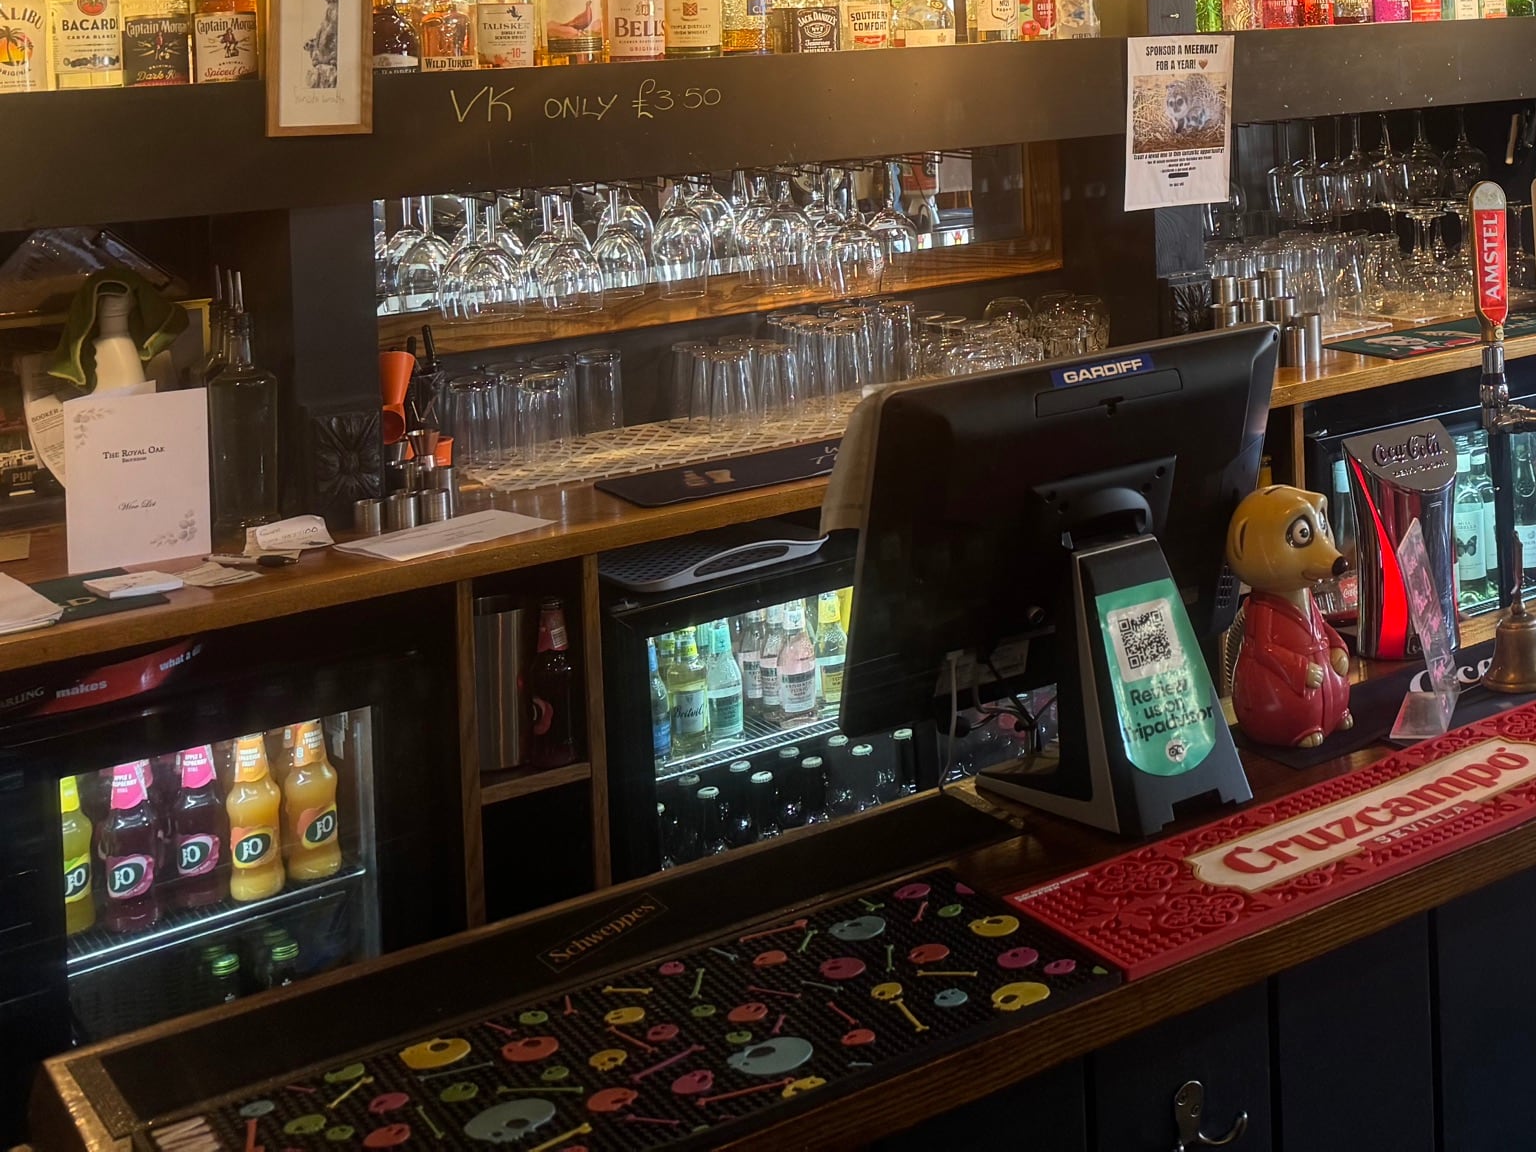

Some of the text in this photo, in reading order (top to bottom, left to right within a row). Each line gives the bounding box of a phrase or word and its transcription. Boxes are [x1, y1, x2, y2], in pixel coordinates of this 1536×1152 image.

[0, 6, 44, 32] ALIBU
[196, 17, 257, 36] Captain Morga
[1145, 45, 1177, 57] SPONSOR
[1184, 43, 1219, 55] MEERKAT
[424, 58, 447, 69] WILD
[1156, 60, 1169, 71] FOR
[1177, 59, 1197, 70] YEAR!
[450, 86, 516, 123] VK
[543, 93, 619, 121] ONLY
[1484, 213, 1500, 302] AMSTEL
[1063, 358, 1143, 384] GARDIFF
[102, 450, 120, 461] THE
[121, 448, 147, 459] ROYAL
[148, 445, 166, 455] OAK
[55, 679, 108, 699] makes
[159, 653, 185, 672] what
[1129, 678, 1188, 706] Review
[1143, 696, 1187, 721] us on
[1222, 746, 1530, 875] Cruzcampo
[1374, 804, 1469, 845] SEVILLA
[548, 904, 656, 963] Schweppes
